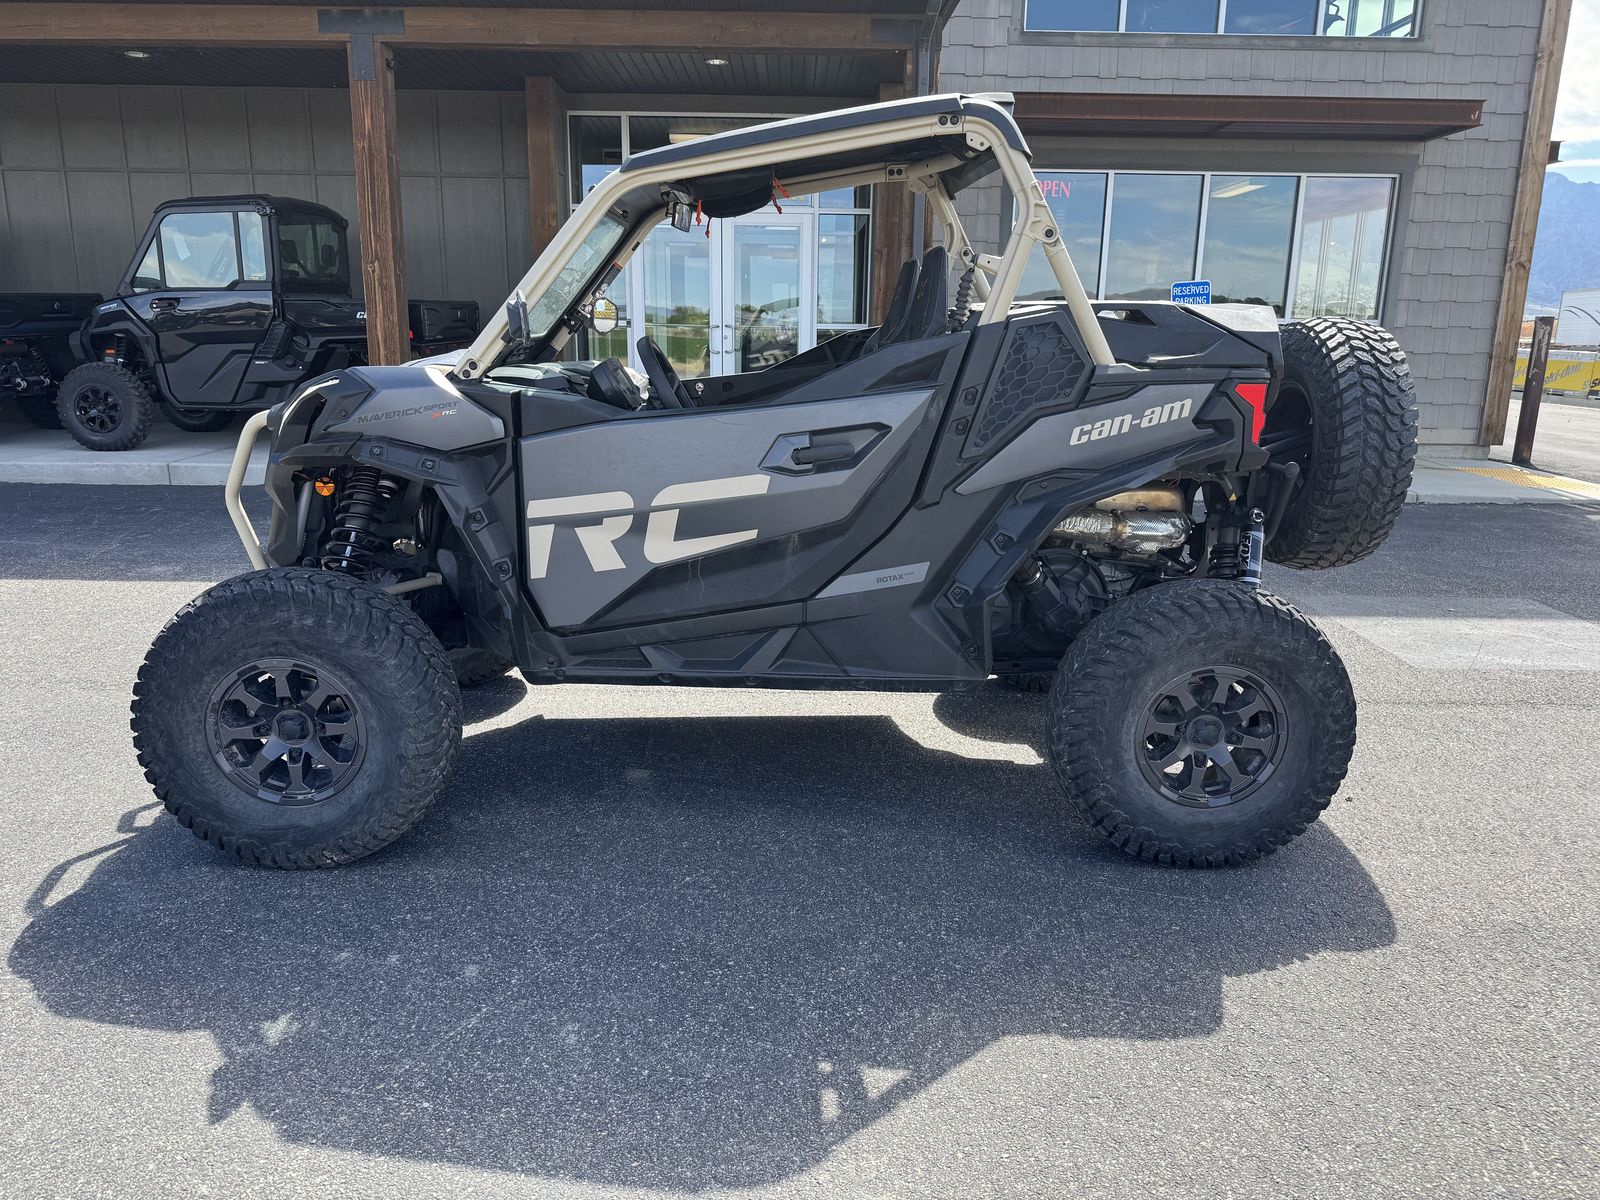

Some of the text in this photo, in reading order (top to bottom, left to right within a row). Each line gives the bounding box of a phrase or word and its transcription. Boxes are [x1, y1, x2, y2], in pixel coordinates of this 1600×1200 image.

[1173, 285, 1210, 296] RESERVED
[356, 401, 459, 424] MAVERICK SPORT
[1069, 398, 1193, 446] can-am
[526, 474, 771, 579] RC
[1240, 531, 1253, 570] FOX
[876, 574, 904, 584] ROTAX
